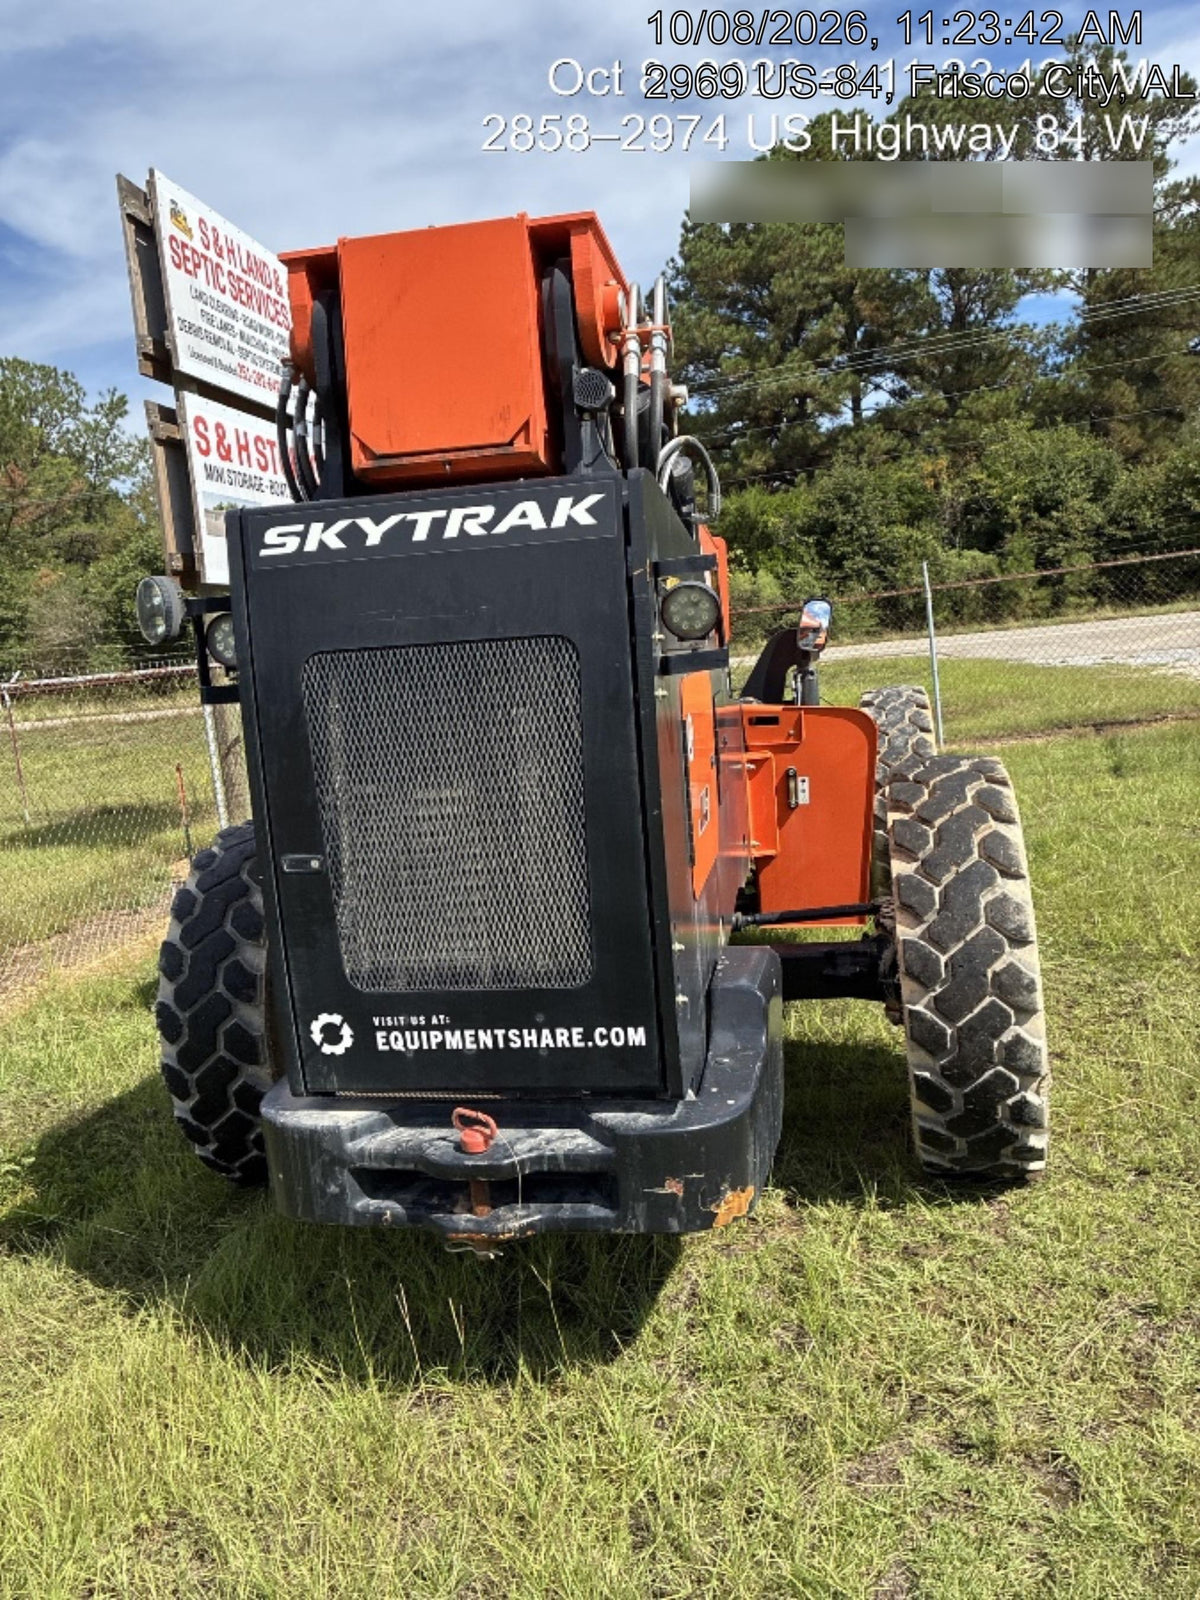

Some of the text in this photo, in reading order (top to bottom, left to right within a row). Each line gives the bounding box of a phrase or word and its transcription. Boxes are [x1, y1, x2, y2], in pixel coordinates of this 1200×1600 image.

[168, 233, 291, 332] SEPTIC SERVICES
[198, 217, 285, 299] S & H LAND &
[193, 415, 211, 457] S
[214, 421, 233, 464] &
[234, 428, 253, 469] H
[226, 468, 265, 493] STORAGE
[258, 493, 606, 558] SKYTRAK
[373, 1015, 406, 1027] VISIT
[410, 1016, 426, 1026] US
[375, 1026, 647, 1052] EQUIPMENTSHARE.COM
